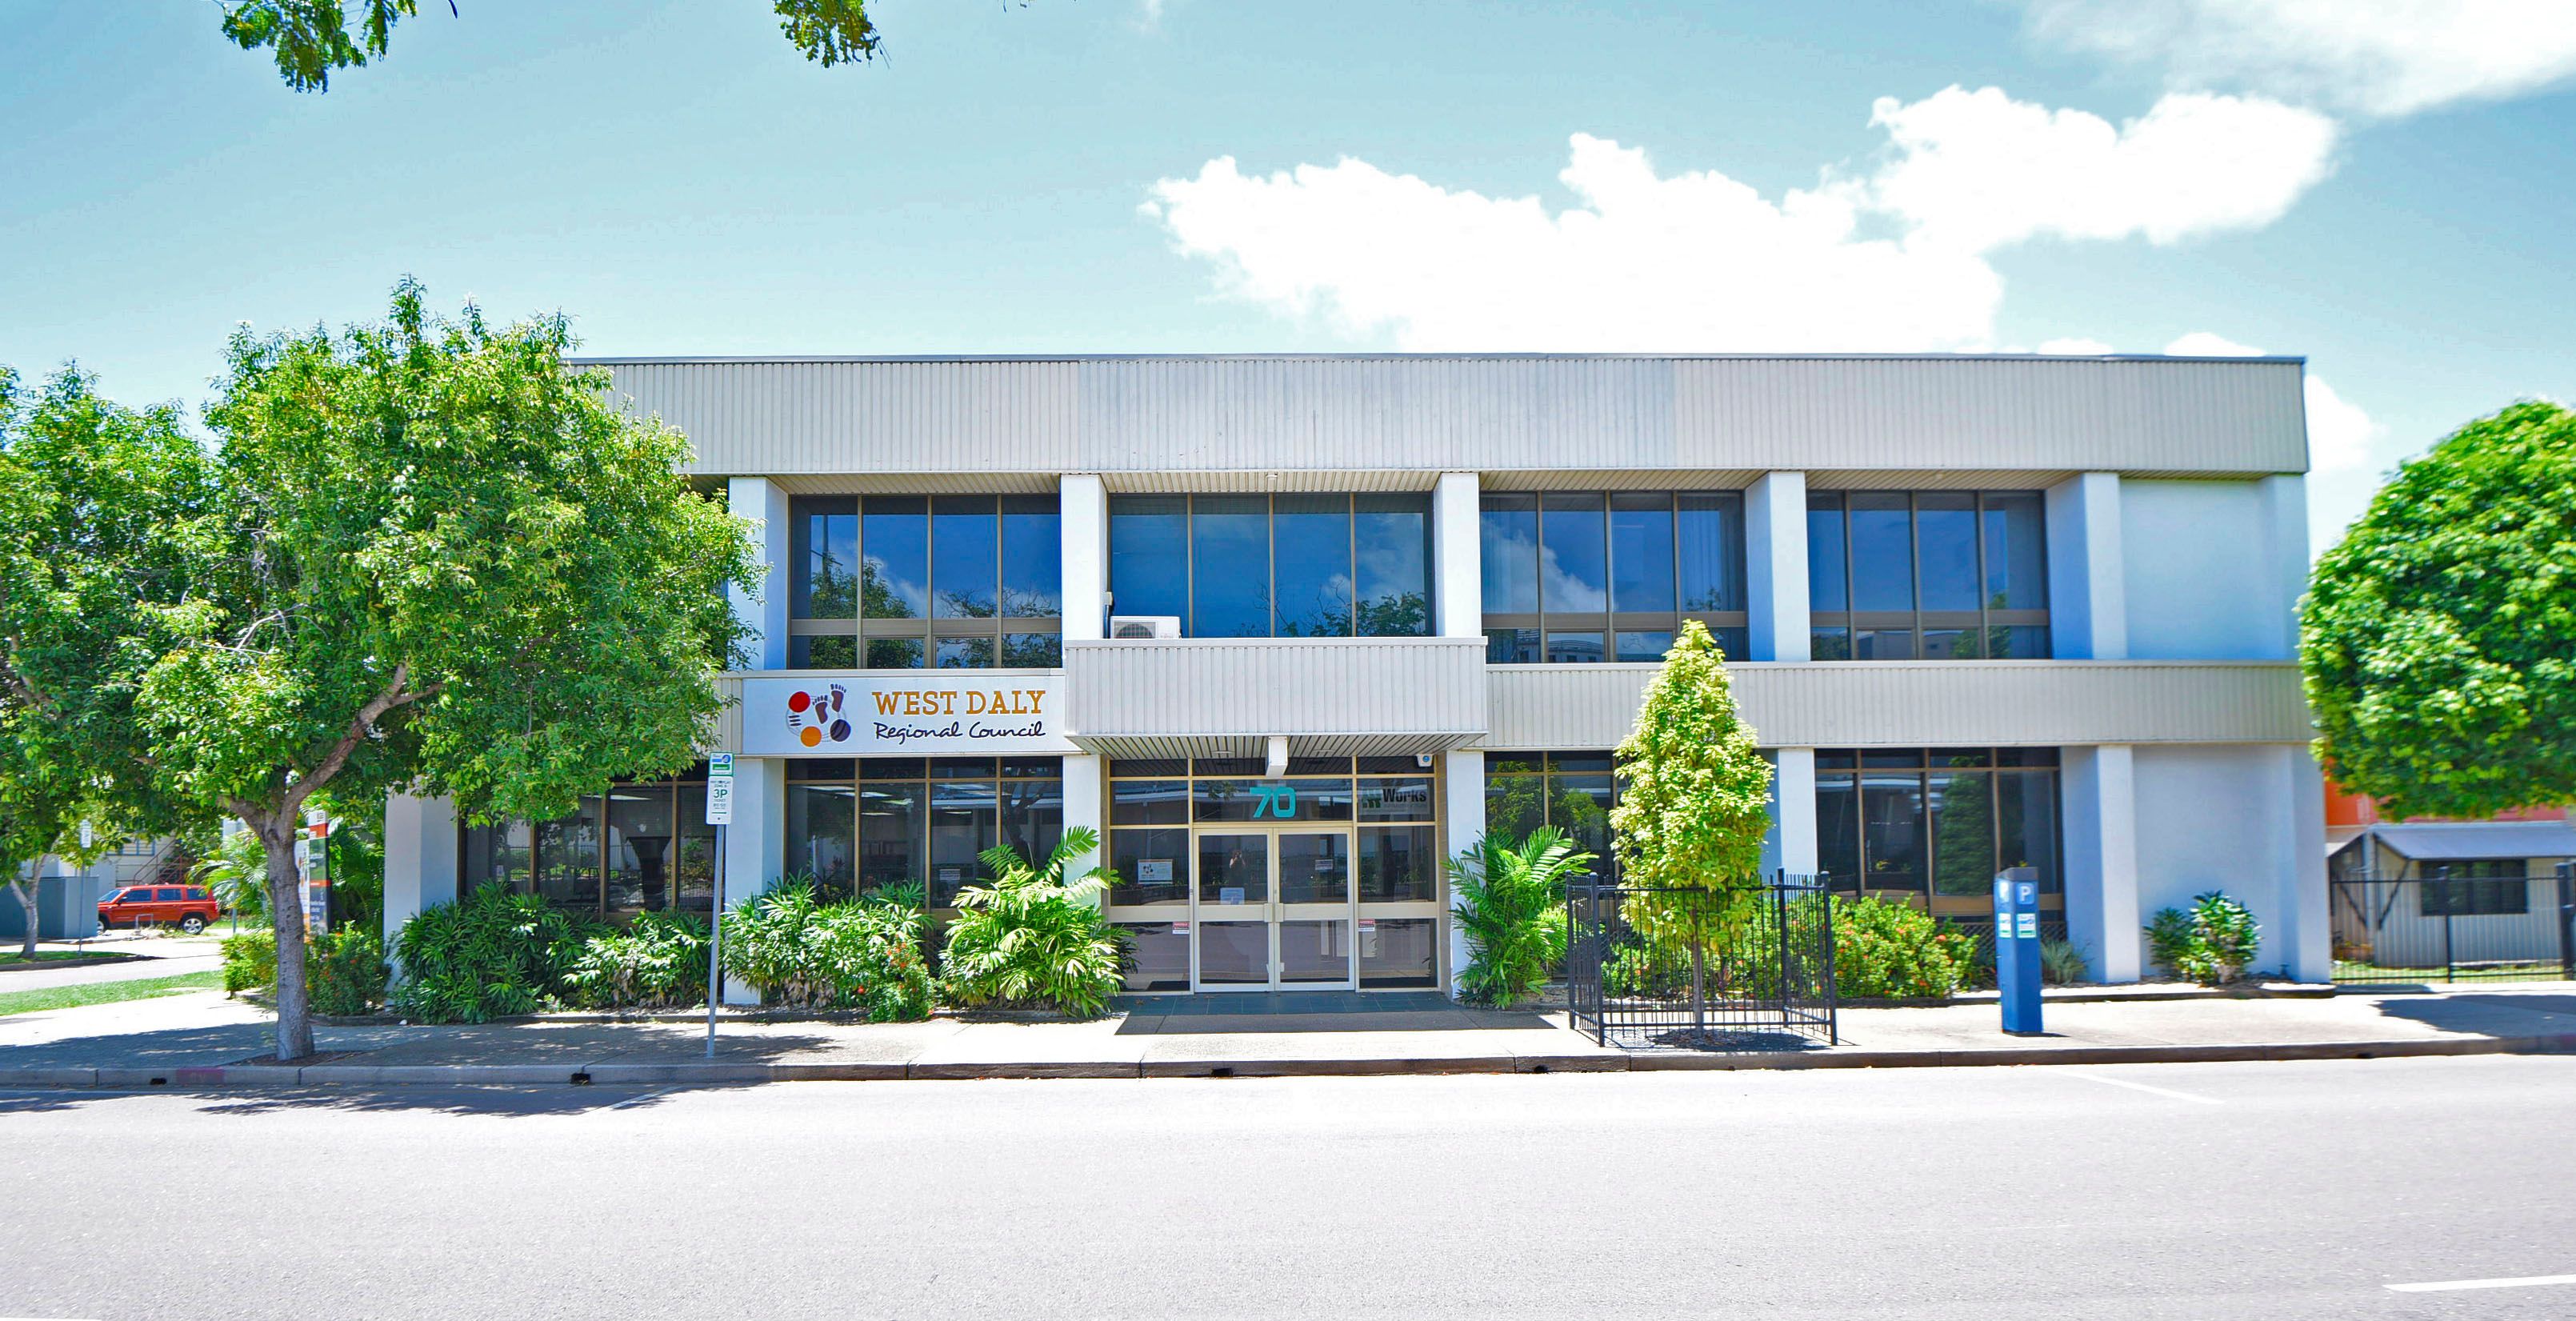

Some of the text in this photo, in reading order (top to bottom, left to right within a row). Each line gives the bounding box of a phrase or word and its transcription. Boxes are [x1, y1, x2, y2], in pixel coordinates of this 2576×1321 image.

[872, 690, 1046, 715] WEST DALY
[874, 720, 1046, 745] Regional Council
[714, 788, 727, 798] 3P
[1250, 787, 1296, 818] 70
[1382, 788, 1427, 803] Works
[2020, 886, 2031, 901] P
